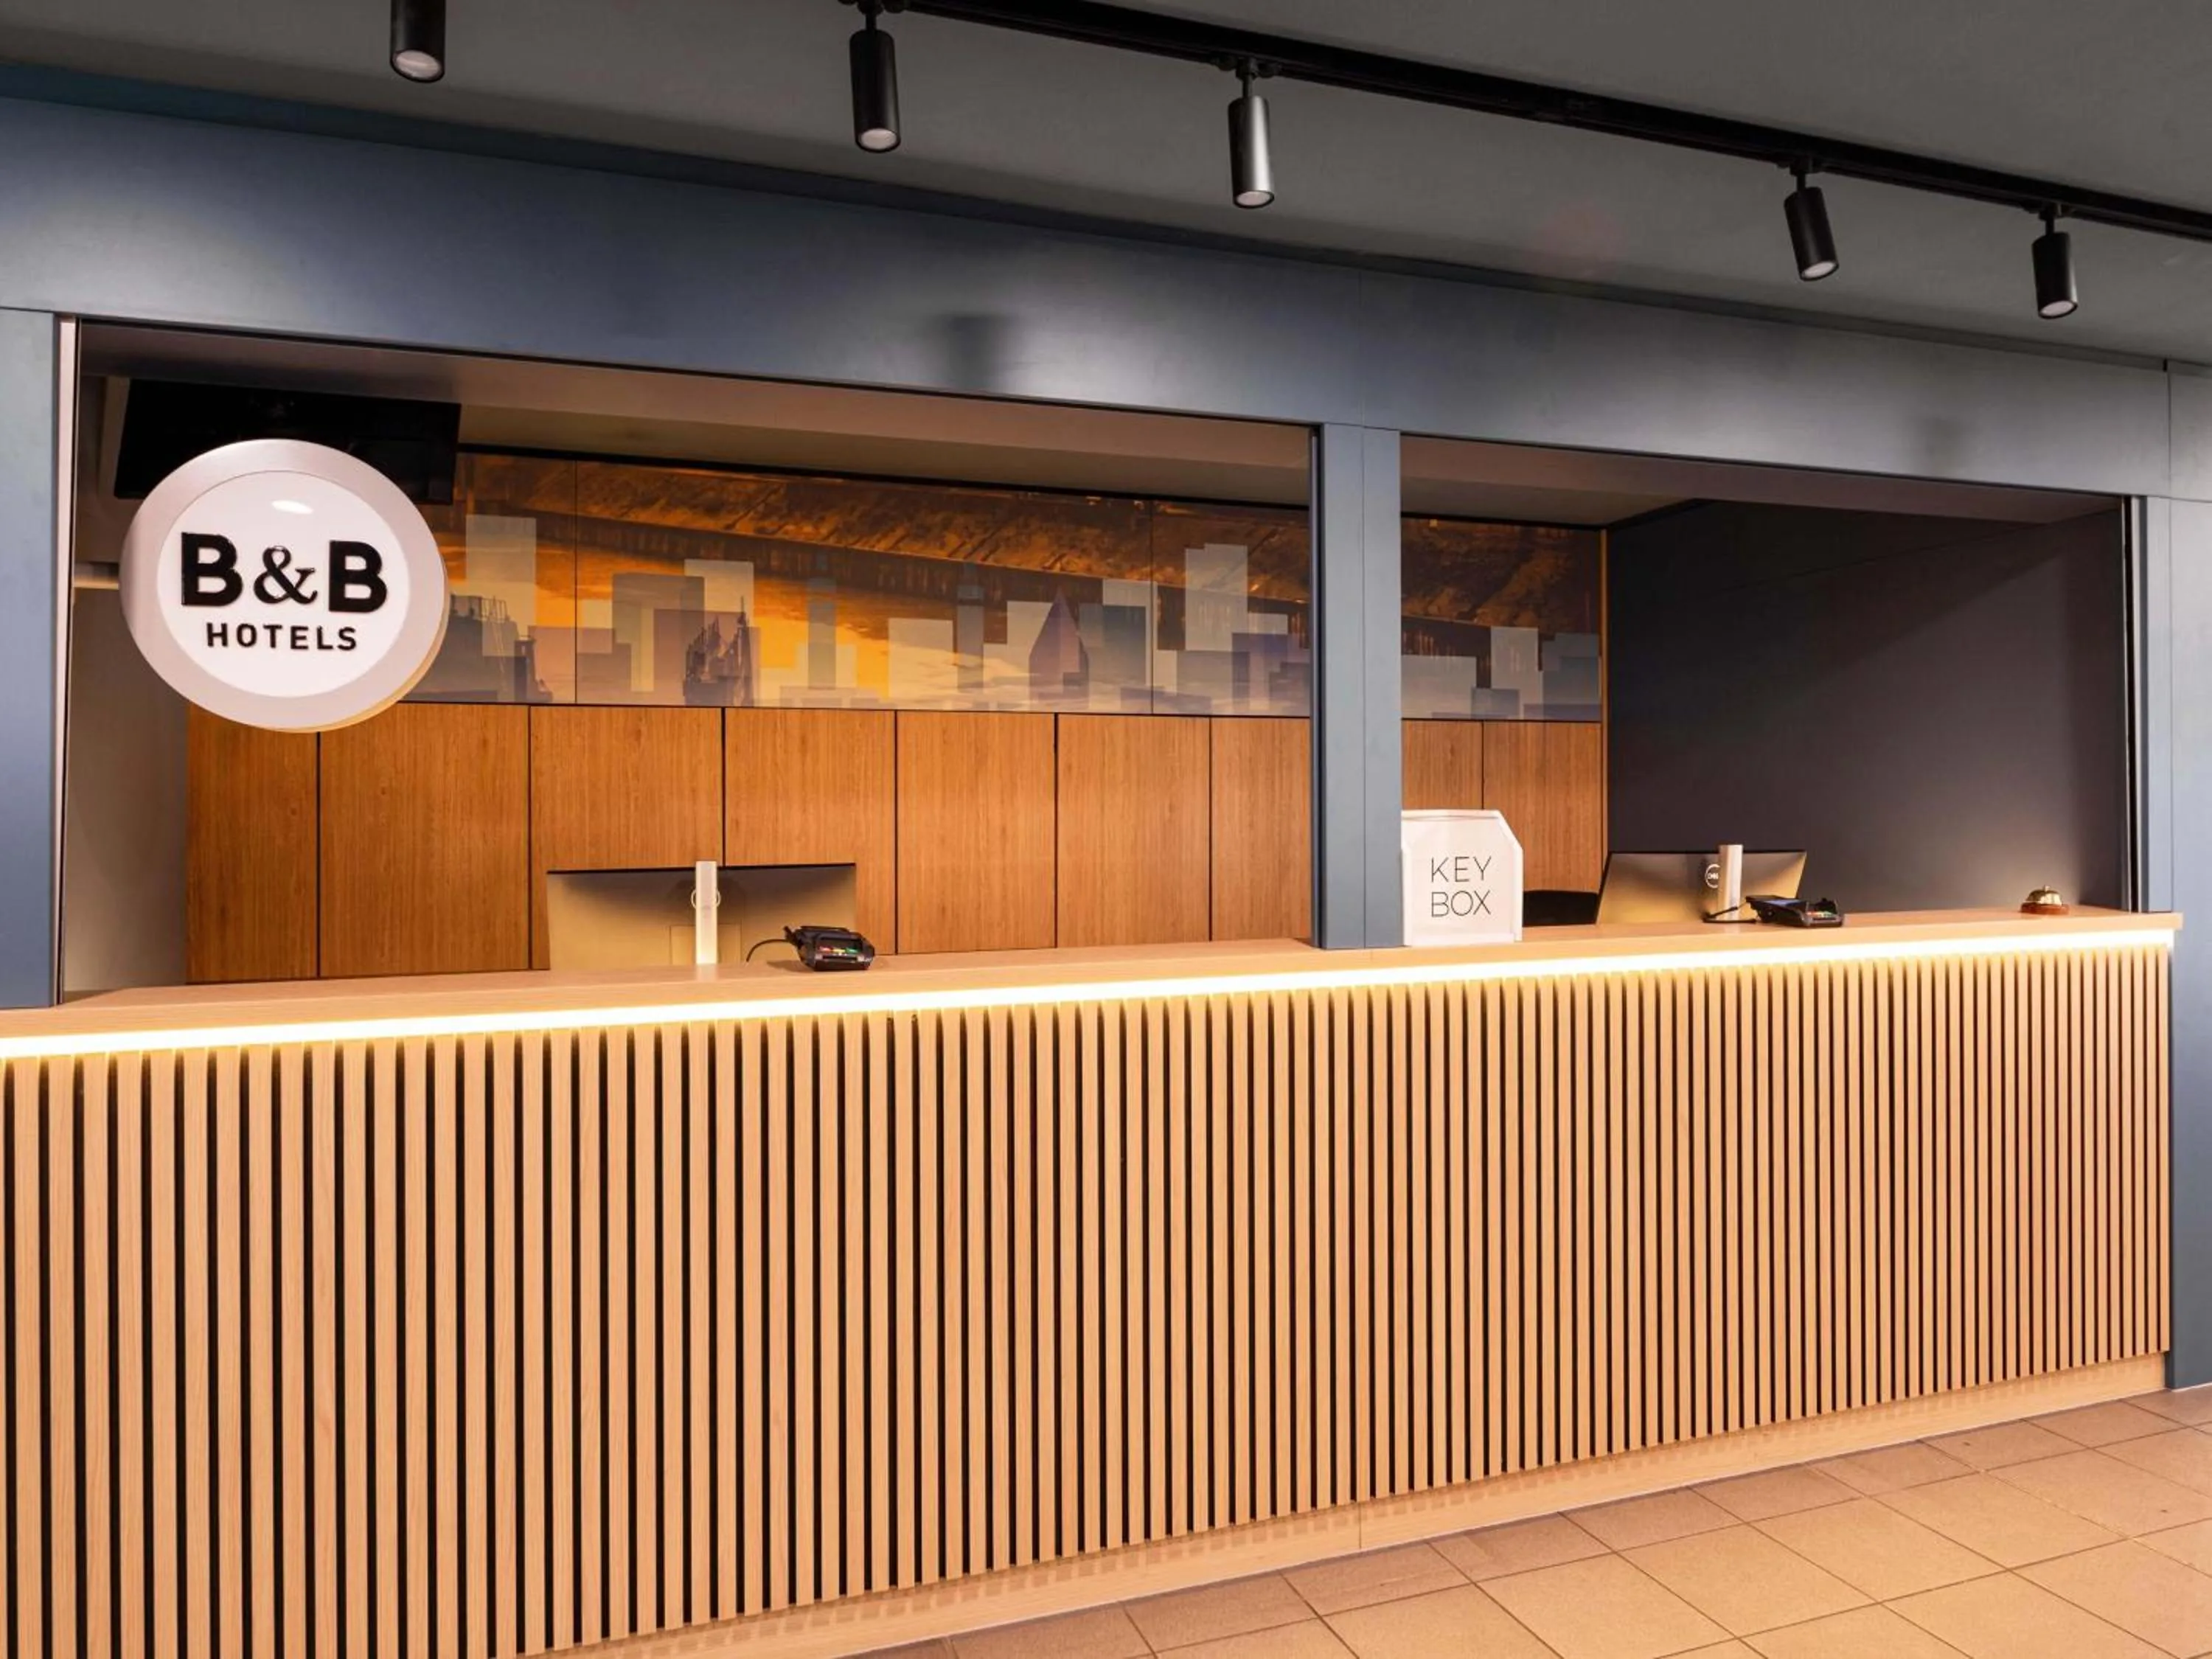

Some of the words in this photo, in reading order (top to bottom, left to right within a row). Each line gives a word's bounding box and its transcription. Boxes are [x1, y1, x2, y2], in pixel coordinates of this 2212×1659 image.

[181, 532, 388, 613] B&B
[206, 622, 357, 651] HOTELS
[1431, 855, 1492, 883] KEY
[1431, 889, 1492, 918] BOX
